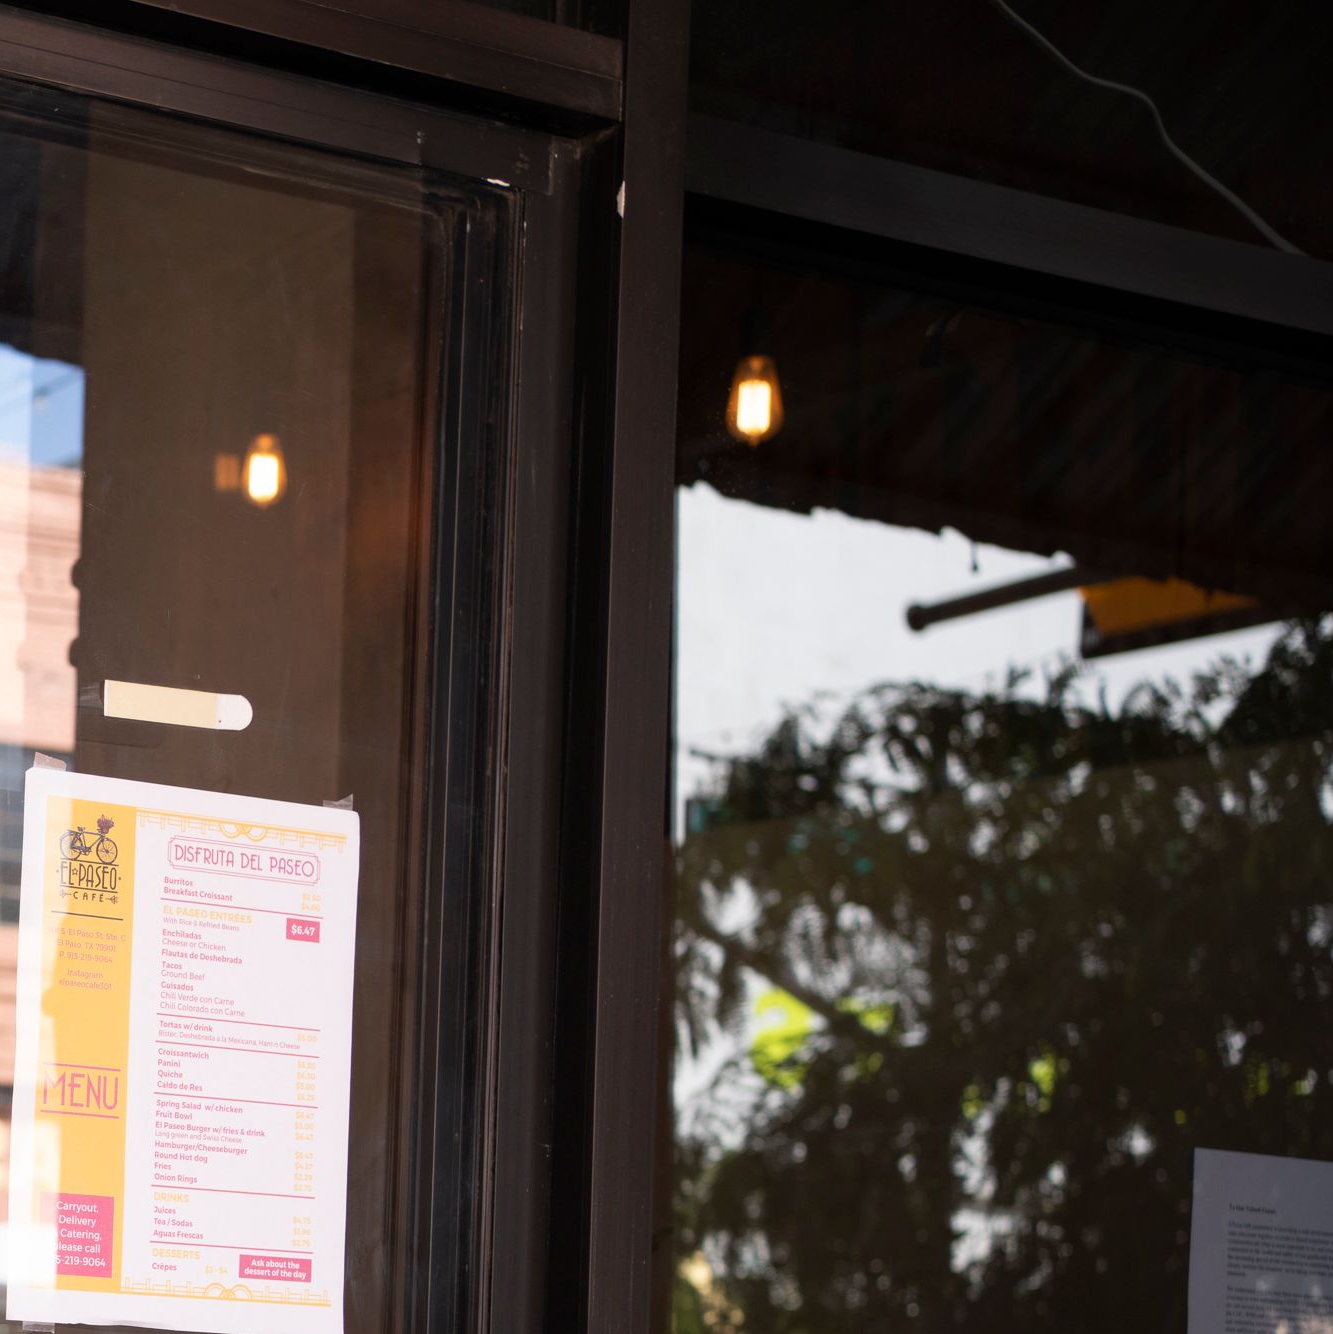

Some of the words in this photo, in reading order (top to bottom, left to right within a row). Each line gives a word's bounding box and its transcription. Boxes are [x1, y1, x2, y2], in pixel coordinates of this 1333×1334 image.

[174, 844, 234, 868] DISFRUTA
[240, 852, 263, 871] DEL
[269, 856, 315, 877] PASEO
[60, 860, 74, 885] EL
[78, 863, 117, 890] PASEO
[164, 876, 193, 887] Burritos
[73, 891, 104, 902] CAFÉ
[164, 886, 198, 898] Breakfast
[199, 890, 233, 902] Croissant
[163, 904, 174, 915] EL
[176, 906, 208, 918] PASEO
[221, 923, 240, 931] Beans
[291, 923, 315, 937] $6.47
[162, 928, 202, 940] Enchiladas
[162, 937, 188, 947] Cheese
[198, 941, 226, 951] Chicken
[161, 948, 188, 959] Flautas
[189, 951, 198, 959] de
[199, 952, 243, 965] Deshebrada
[161, 960, 183, 970] Tacos
[67, 968, 104, 980] Instagram
[161, 969, 187, 979] Ground
[189, 971, 205, 981] Beef
[161, 980, 194, 992] Guisados
[177, 992, 198, 1002] Verde
[199, 996, 213, 1004] con
[214, 996, 234, 1006] Carne
[177, 1002, 209, 1013] Colorado
[210, 1007, 223, 1015] con
[224, 1007, 245, 1017] Carne
[159, 1020, 182, 1030] Tortas
[279, 1041, 300, 1050] Cheese
[158, 1047, 210, 1059] Croissantwich
[157, 1058, 181, 1068] Panini
[157, 1069, 183, 1079] Quiche
[42, 1070, 119, 1110] MENU
[157, 1080, 177, 1090] Caldo
[178, 1082, 188, 1091] de
[189, 1083, 203, 1092] Res
[156, 1099, 180, 1110] Spring
[181, 1101, 202, 1110] Salad
[156, 1110, 173, 1119] Fruit
[174, 1111, 192, 1120] Bowl
[155, 1121, 163, 1129] El
[164, 1121, 185, 1131] Paseo
[186, 1124, 211, 1135] Burger
[240, 1128, 246, 1136] &
[246, 1128, 266, 1138] drink
[171, 1133, 188, 1141] green
[189, 1132, 202, 1140] and
[202, 1133, 219, 1142] Swiss
[220, 1135, 243, 1144] Cheese
[155, 1140, 248, 1156] Hamburger/Cheeseburger
[154, 1151, 178, 1161] Round
[179, 1153, 193, 1161] Hot
[194, 1154, 208, 1164] dog
[154, 1161, 172, 1170] Fries
[154, 1172, 176, 1182] Onion
[177, 1174, 198, 1185] Rings
[153, 1191, 189, 1203] DRINKS
[153, 1206, 176, 1215] Juices
[58, 1214, 96, 1228] Delivery
[153, 1217, 166, 1226] Tea
[171, 1218, 193, 1227] Sodas
[153, 1229, 176, 1240] Aguas
[177, 1230, 204, 1240] Frescas
[84, 1243, 101, 1254] call
[152, 1248, 200, 1260] DESSERTS
[151, 1262, 177, 1273] Crêpes
[251, 1258, 265, 1268] Ask
[265, 1260, 287, 1269] about
[287, 1261, 300, 1270] the
[244, 1266, 271, 1276] dessert
[271, 1267, 279, 1276] of
[280, 1268, 292, 1277] the
[292, 1270, 306, 1280] day
